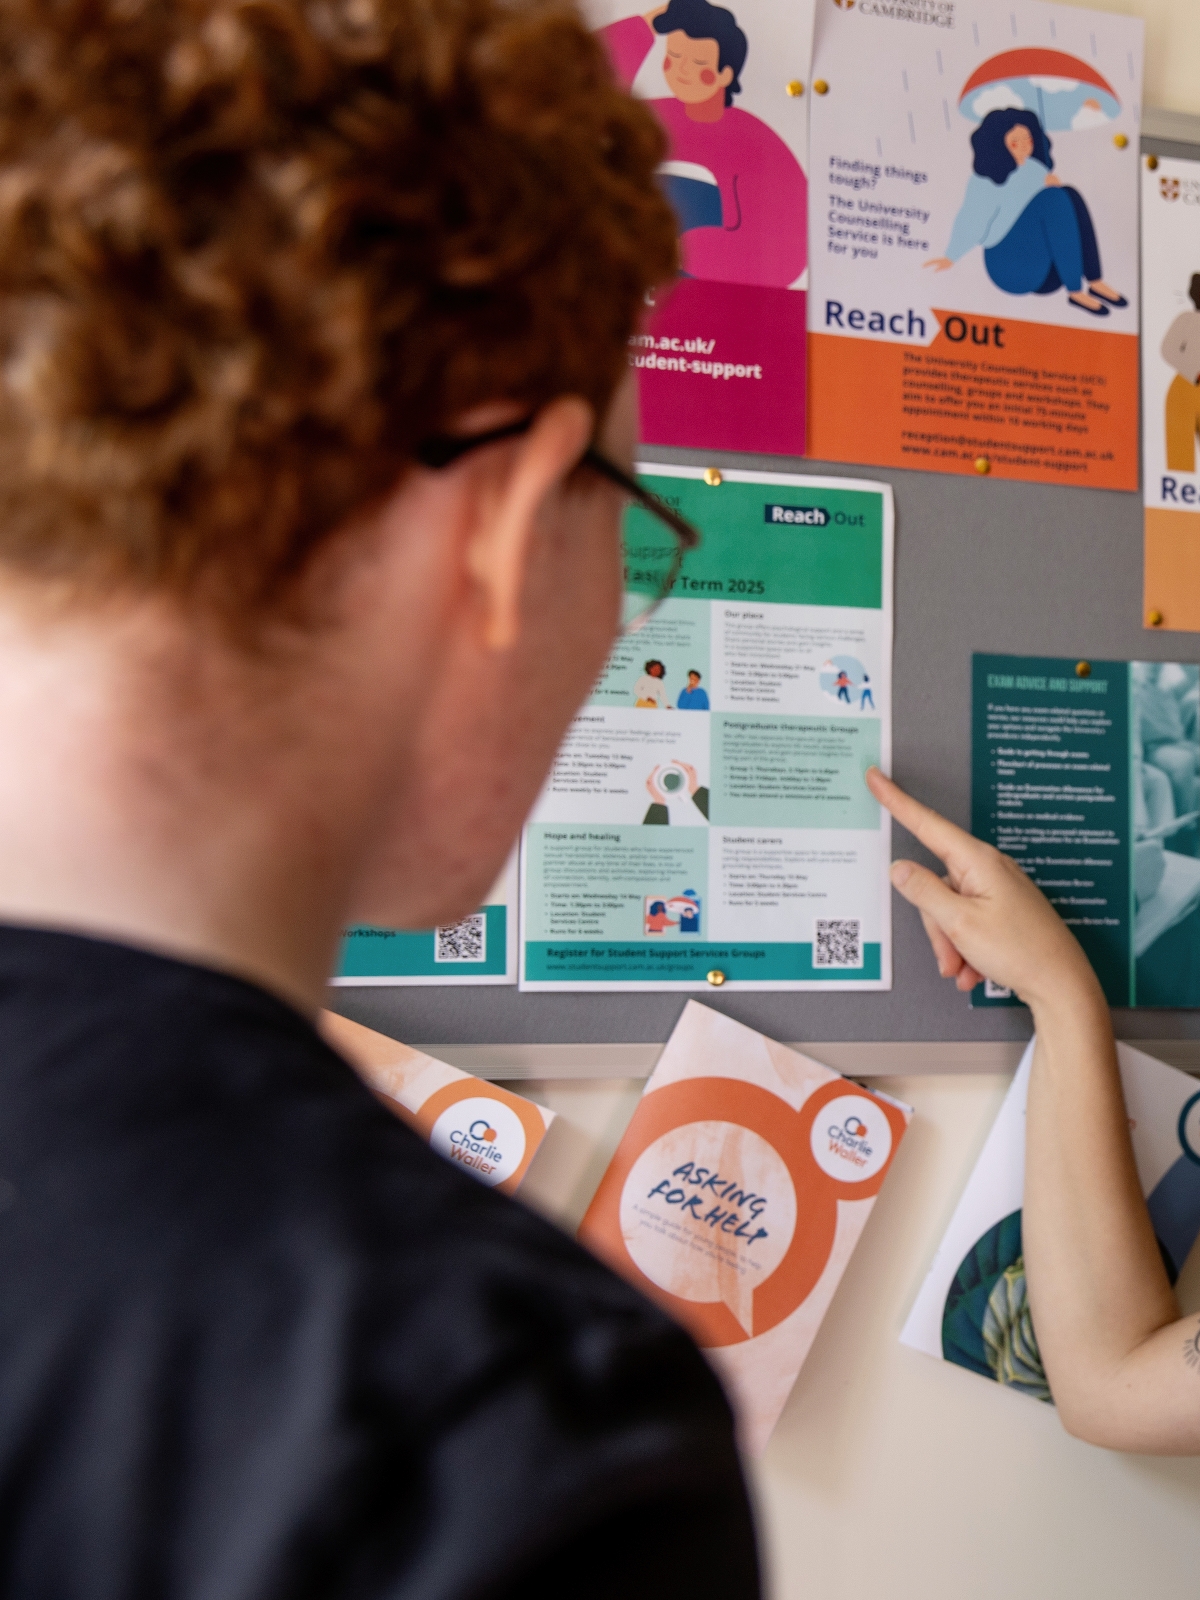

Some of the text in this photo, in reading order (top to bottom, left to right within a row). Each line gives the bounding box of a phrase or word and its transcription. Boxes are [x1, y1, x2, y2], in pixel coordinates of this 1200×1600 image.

[858, 3, 955, 29] CAMBRIDGE
[829, 156, 927, 185] Finding things
[829, 173, 876, 190] tough?
[829, 194, 930, 223] The University
[828, 210, 909, 235] Counselling
[828, 225, 929, 250] Service is here
[828, 240, 878, 259] for you
[825, 300, 1005, 349] Reach Out
[627, 335, 716, 355] am.ac.uk/
[627, 353, 763, 380] tudent-support
[904, 352, 922, 362] The
[925, 354, 977, 372] University
[981, 362, 1039, 380] Counselling
[1042, 369, 1077, 382] Service
[903, 366, 947, 379] provides
[951, 372, 1009, 387] therapeutic
[1013, 379, 1053, 391] services
[1056, 385, 1078, 394] such
[903, 392, 921, 401] aim
[939, 396, 963, 406] offer
[966, 401, 985, 411] you
[1004, 403, 1032, 414] initial
[966, 387, 1002, 399] groups
[1006, 391, 1024, 401] and
[1086, 399, 1110, 413] They
[903, 406, 969, 419] appointment
[972, 413, 1005, 423] within
[1022, 420, 1063, 433] working
[1066, 423, 1088, 434] days
[771, 505, 866, 527] Reach Out
[681, 575, 723, 592] Term
[728, 578, 765, 595] 2025
[724, 610, 764, 621] Our place
[987, 674, 1108, 694] EXAM ADVICE AND SUPPORT
[723, 720, 858, 736] Postgraduate therapeutic Groups
[544, 832, 621, 843] Hope and healing
[722, 836, 755, 845] Student
[546, 948, 766, 961] Register for Student Support Services Groups
[450, 1130, 502, 1162] Charlie
[828, 1125, 873, 1157] Charlie
[829, 1137, 867, 1167] Waller
[450, 1144, 496, 1175] Waller
[672, 1161, 767, 1220] ASKING
[647, 1179, 768, 1245] FOR HELP
